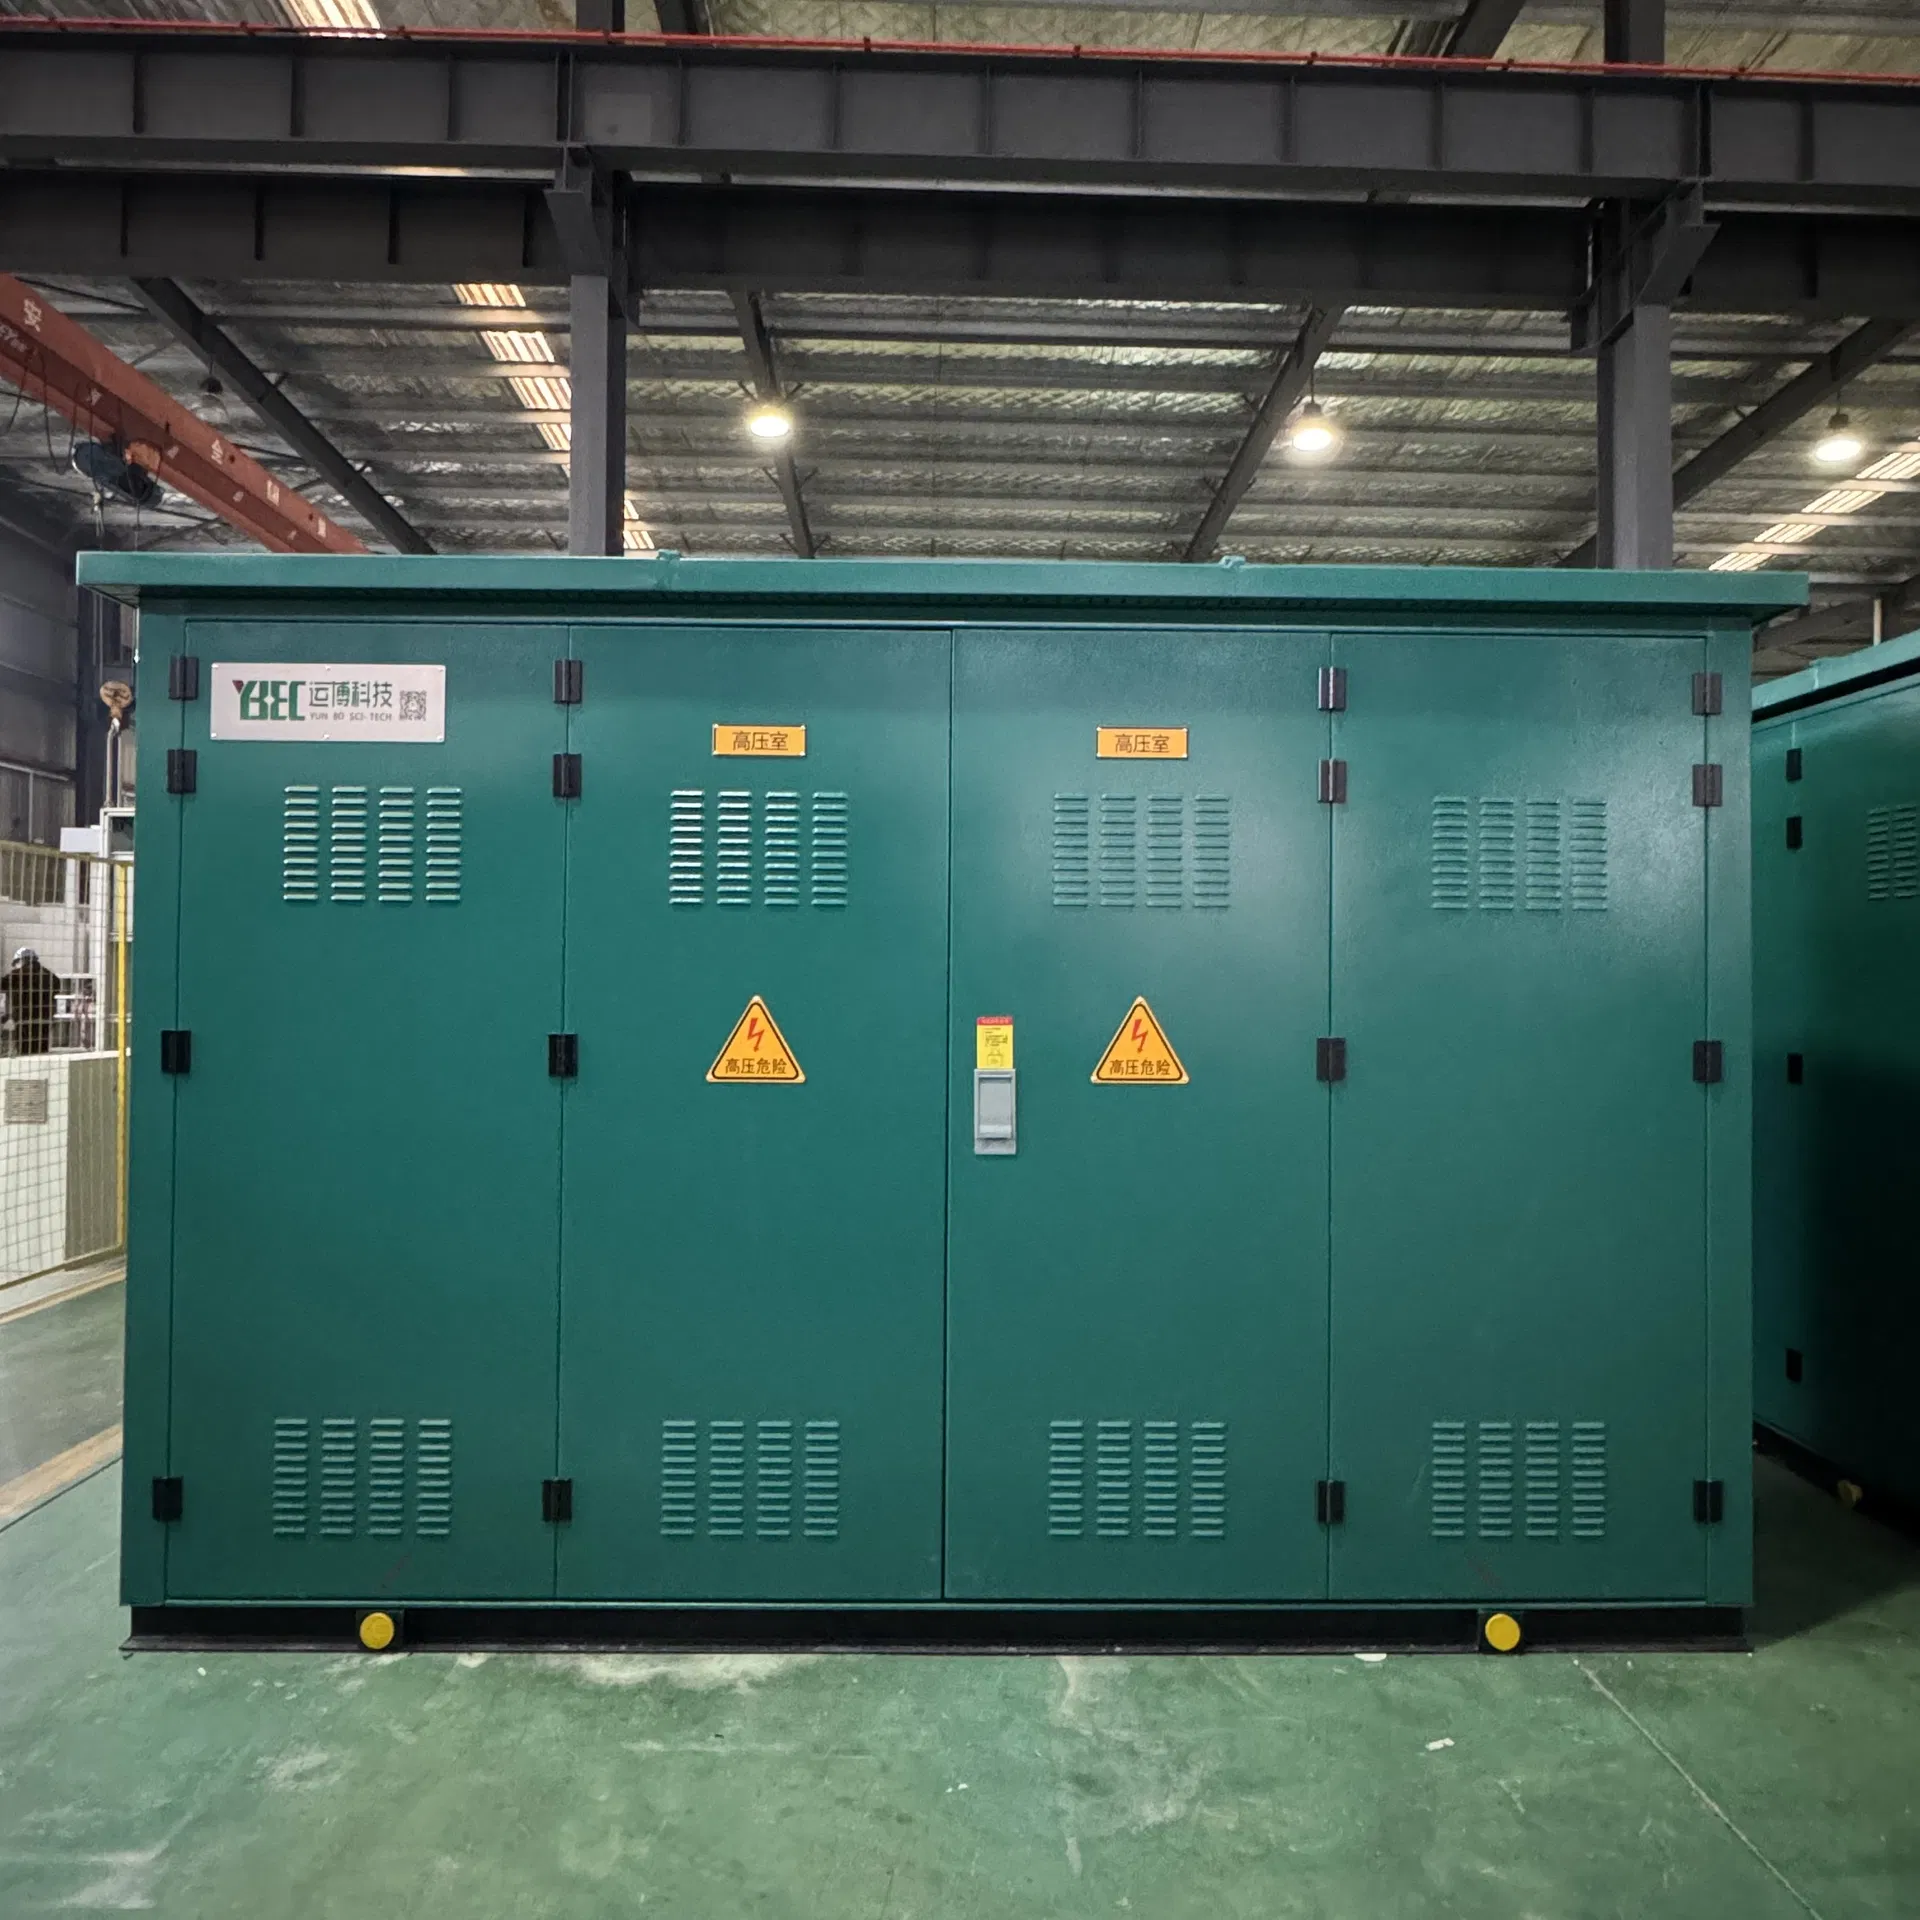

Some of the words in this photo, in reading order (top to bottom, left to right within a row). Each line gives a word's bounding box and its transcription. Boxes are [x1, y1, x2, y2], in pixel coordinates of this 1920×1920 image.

[309, 681, 393, 708] 运博科技
[309, 712, 329, 721] YUN
[333, 712, 345, 721] BO
[732, 731, 789, 751] 高压室
[1114, 733, 1171, 753] 高压室
[725, 1057, 787, 1075] 高压危险
[1109, 1058, 1171, 1076] 高压危险
